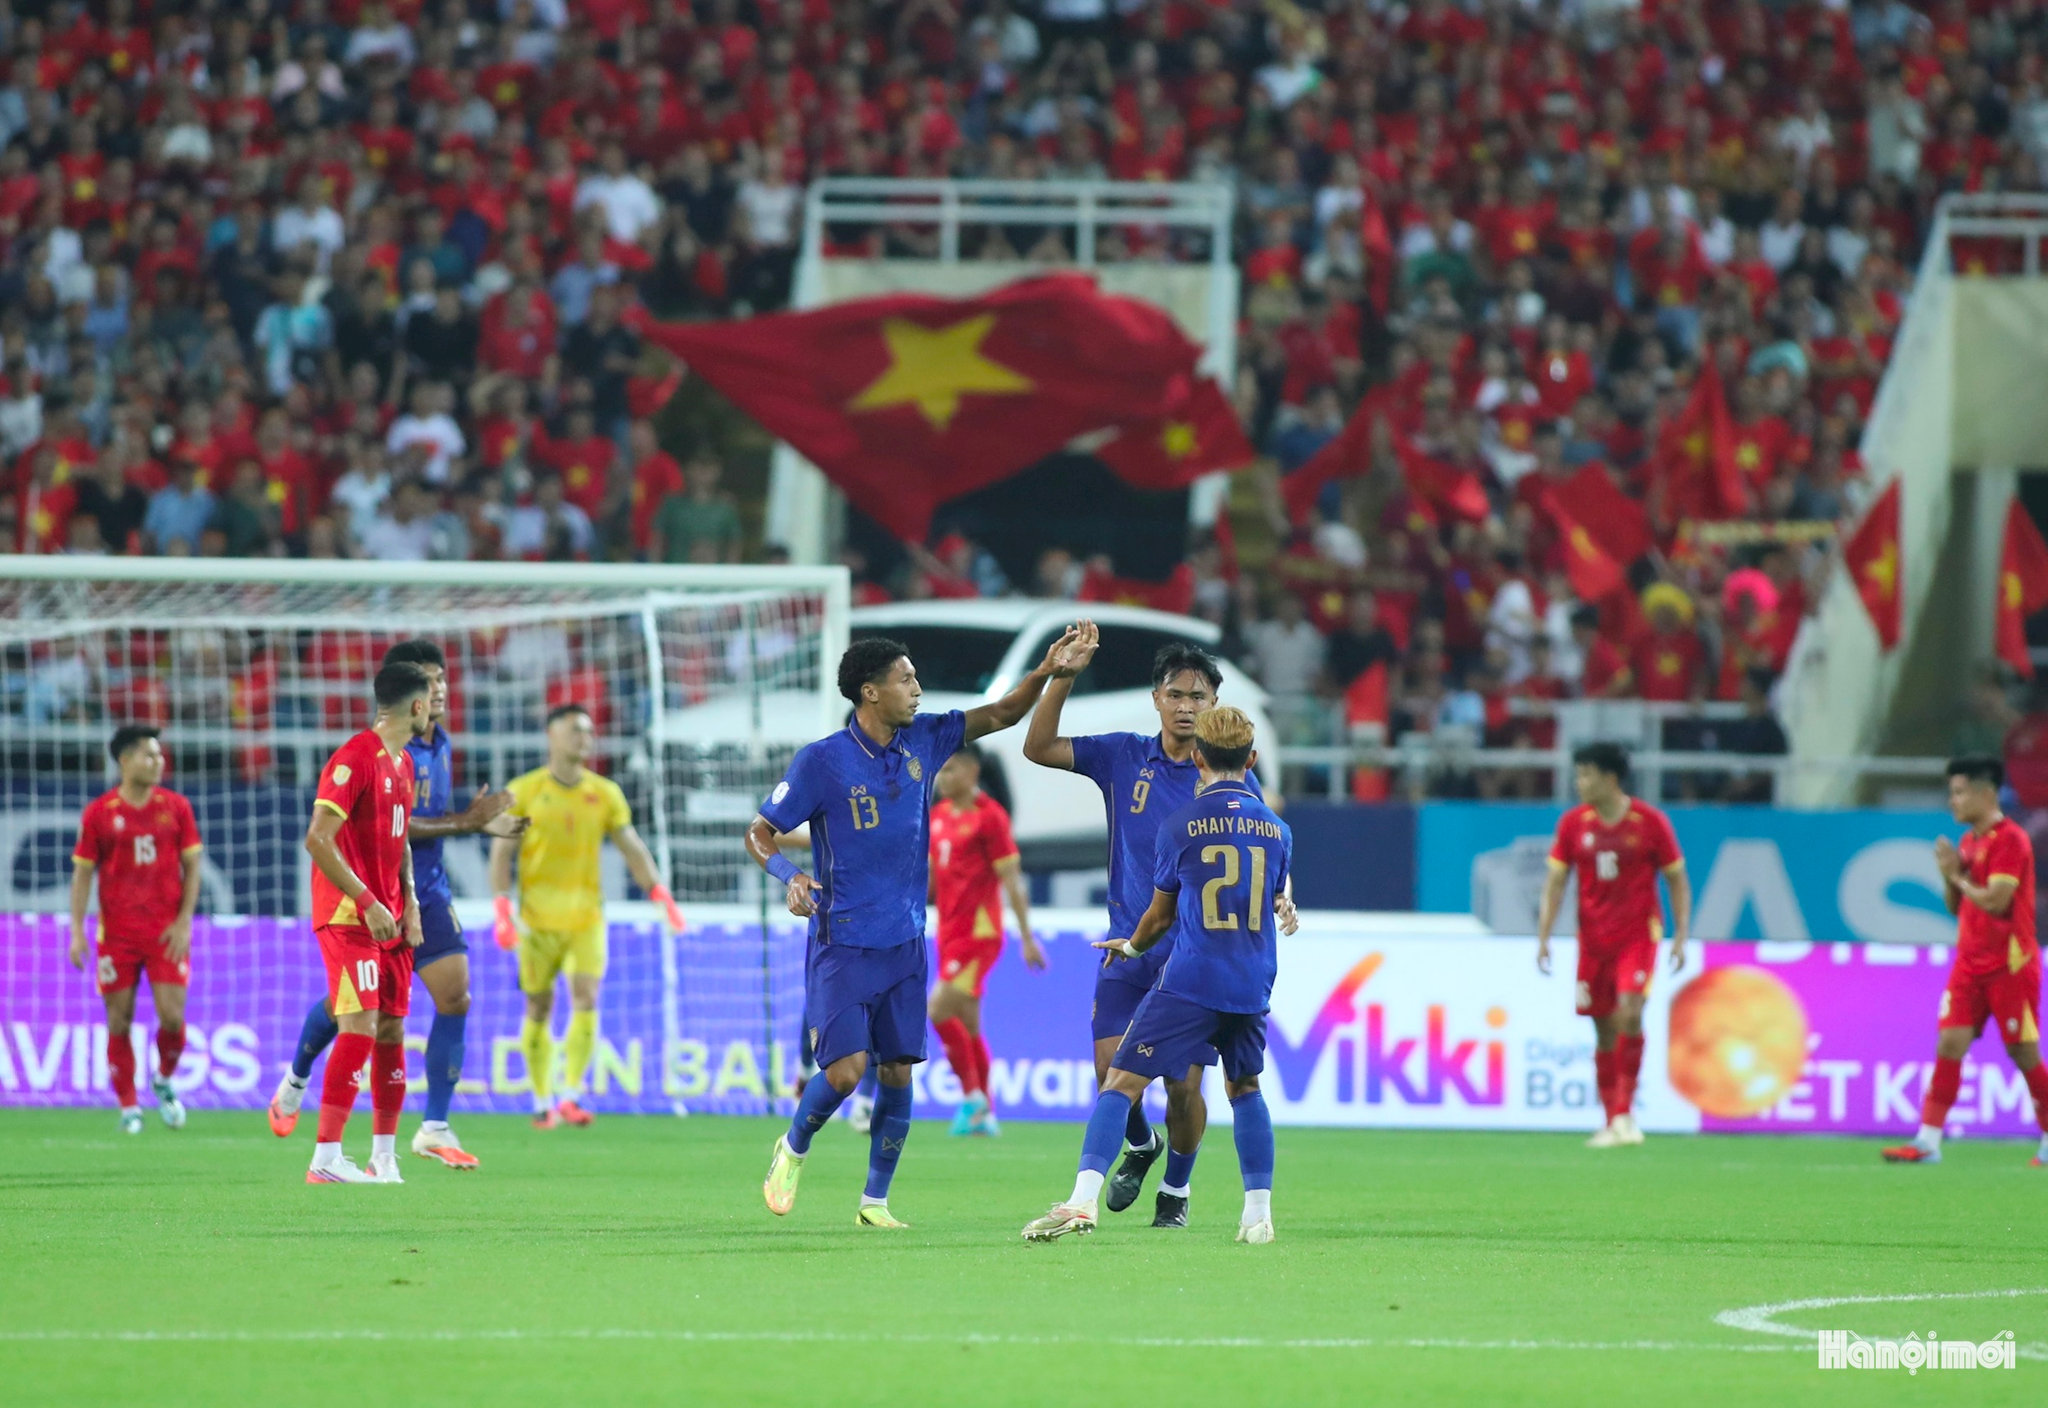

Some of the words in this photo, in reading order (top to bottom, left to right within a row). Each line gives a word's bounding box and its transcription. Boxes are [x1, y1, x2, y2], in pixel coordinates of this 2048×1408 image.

[848, 795, 880, 831] 13
[1130, 781, 1151, 814] 9
[391, 804, 405, 838] 10
[1187, 816, 1283, 841] CHAIYAPHON
[134, 834, 157, 866] 15
[1200, 844, 1266, 931] 21
[356, 959, 379, 992] 10
[1266, 951, 1508, 1105] Vikki
